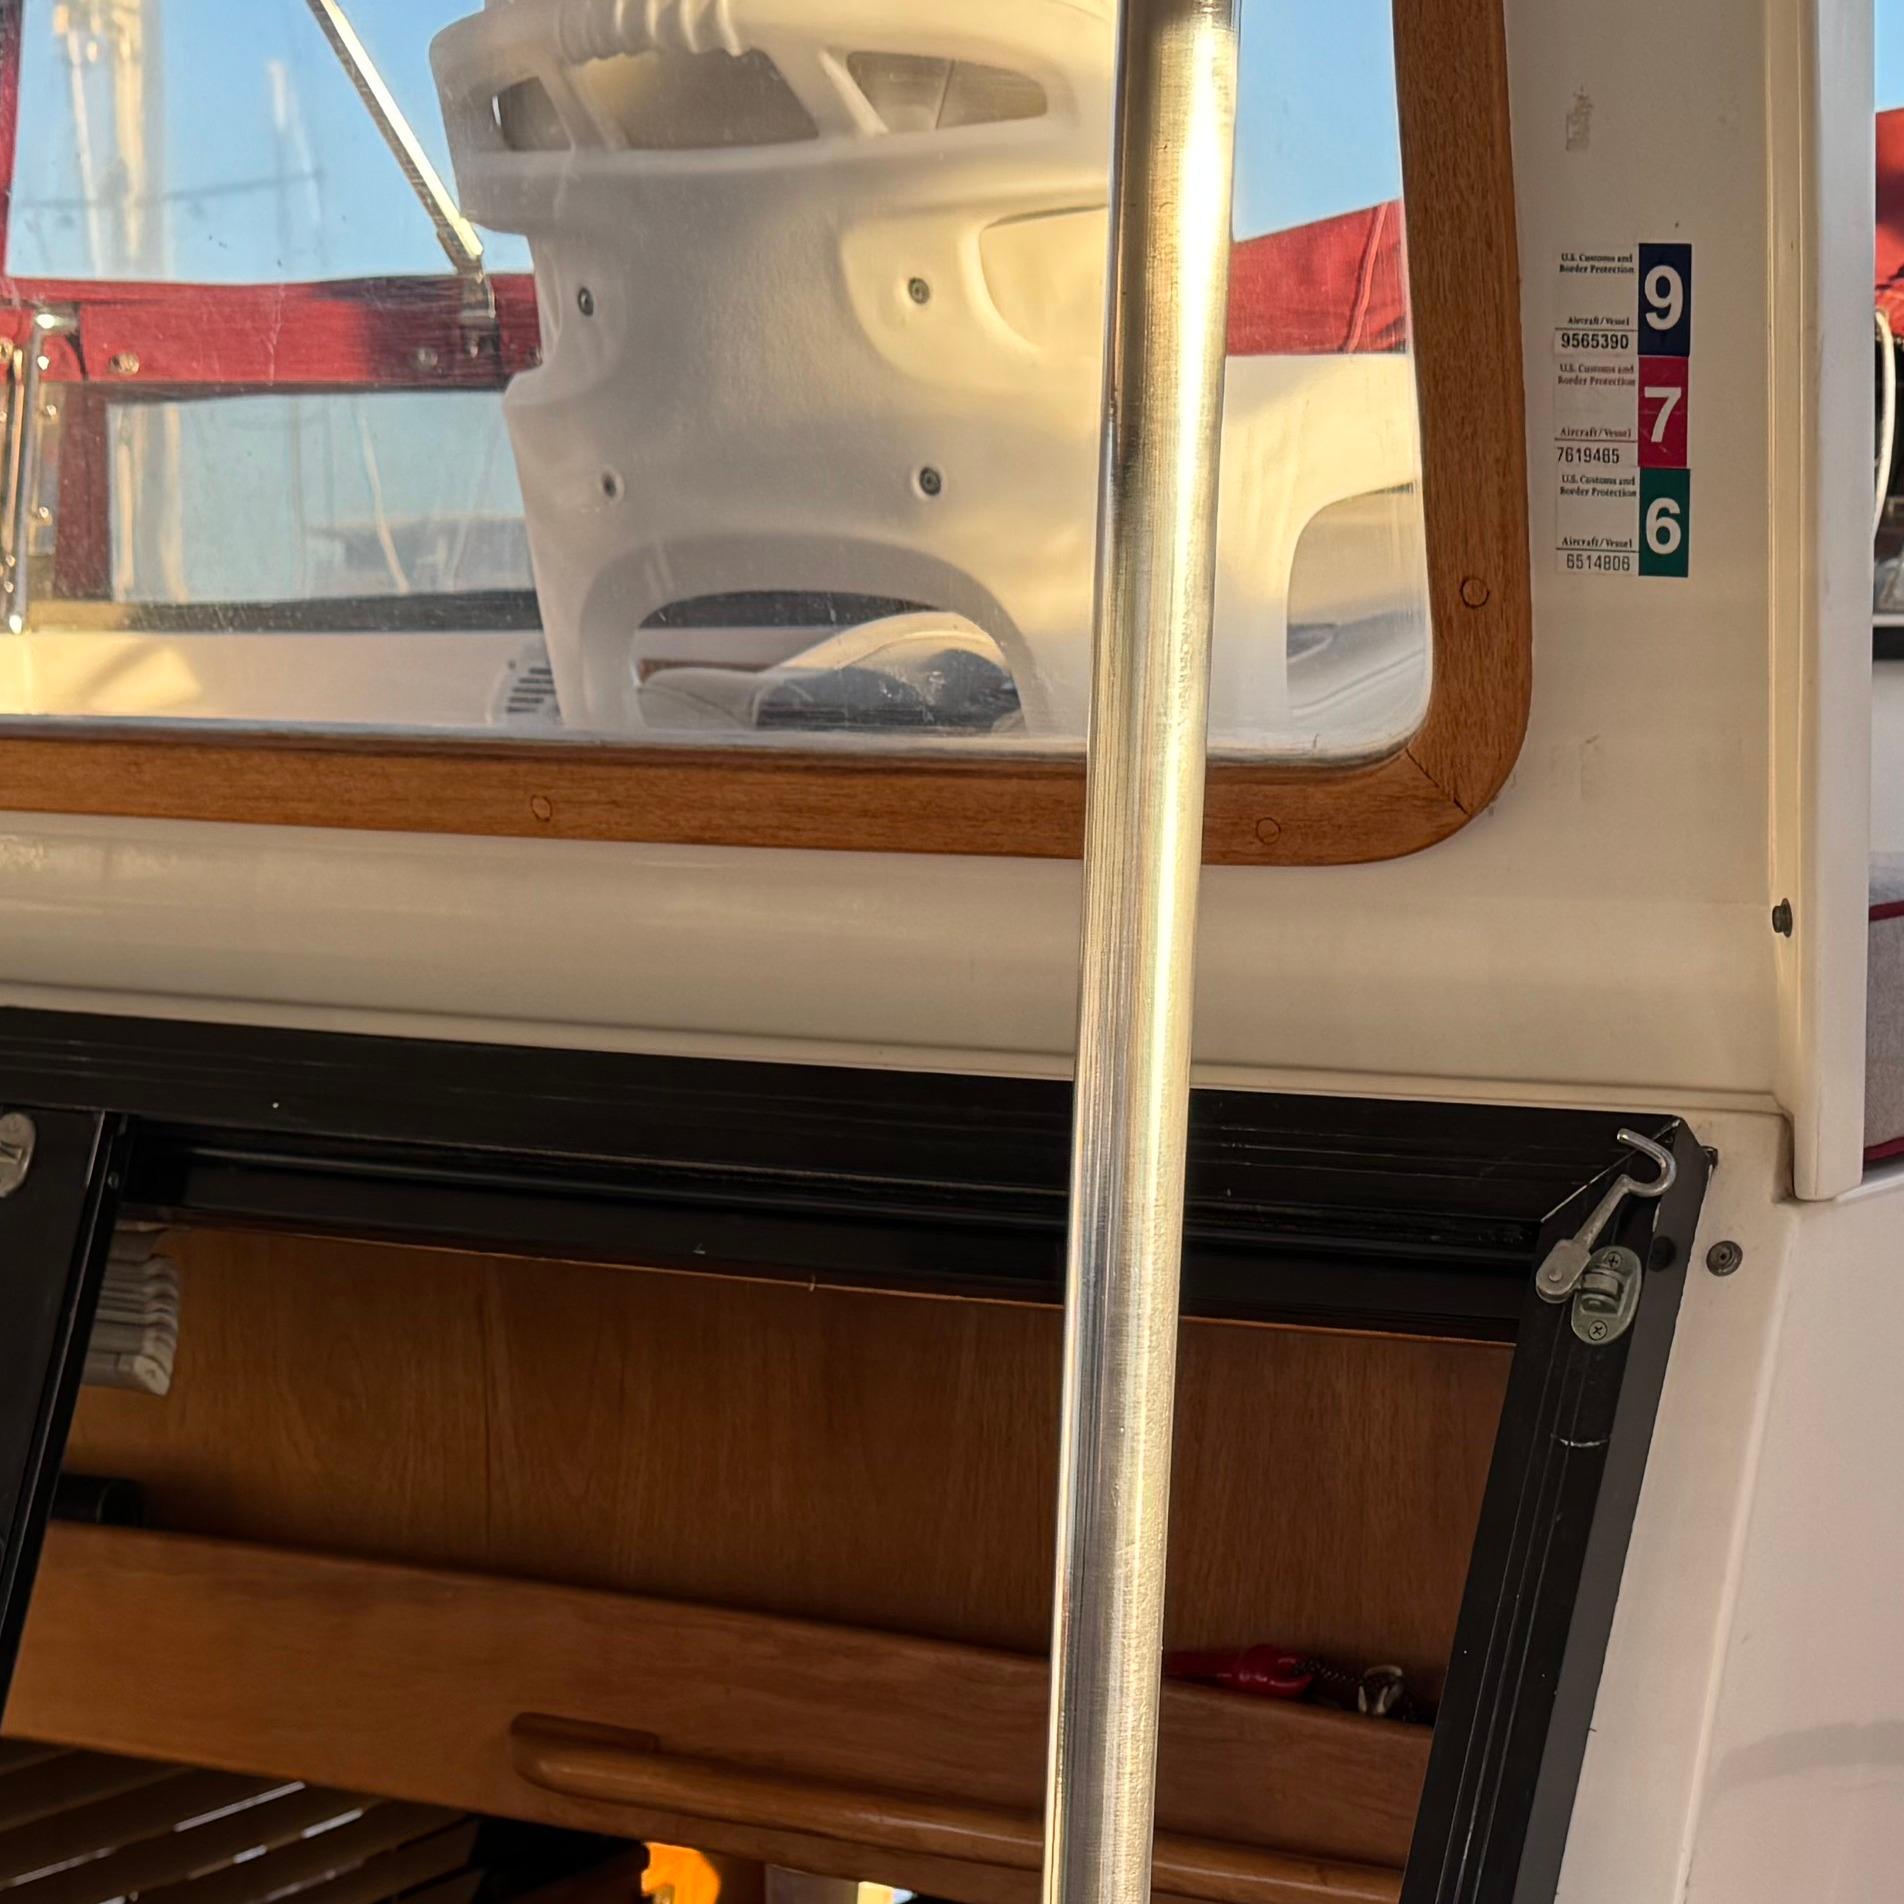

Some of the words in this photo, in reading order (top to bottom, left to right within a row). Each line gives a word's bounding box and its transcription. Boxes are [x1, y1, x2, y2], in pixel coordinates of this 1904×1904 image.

[1579, 253, 1616, 263] Customs
[1617, 253, 1633, 263] and
[1559, 264, 1588, 273] Border
[1590, 264, 1635, 274] Protection
[1644, 264, 1684, 331] 9
[1568, 316, 1630, 326] Aircraft/Vessel
[1560, 332, 1629, 349] 9565390
[1578, 363, 1616, 374] Customs
[1617, 364, 1634, 374] and
[1557, 375, 1587, 386] Border
[1590, 376, 1636, 387] Protection
[1644, 386, 1682, 443] 7
[1560, 427, 1632, 438] Aircraft/Vessel
[1562, 474, 1578, 484] U.S.
[1580, 475, 1617, 486] Customs
[1619, 475, 1636, 486] and
[1560, 486, 1589, 496] Border
[1591, 487, 1637, 498] Protection
[1646, 497, 1682, 555] 6
[1562, 537, 1633, 549] Aircraft/Vessel
[1566, 553, 1631, 572] 6514806
